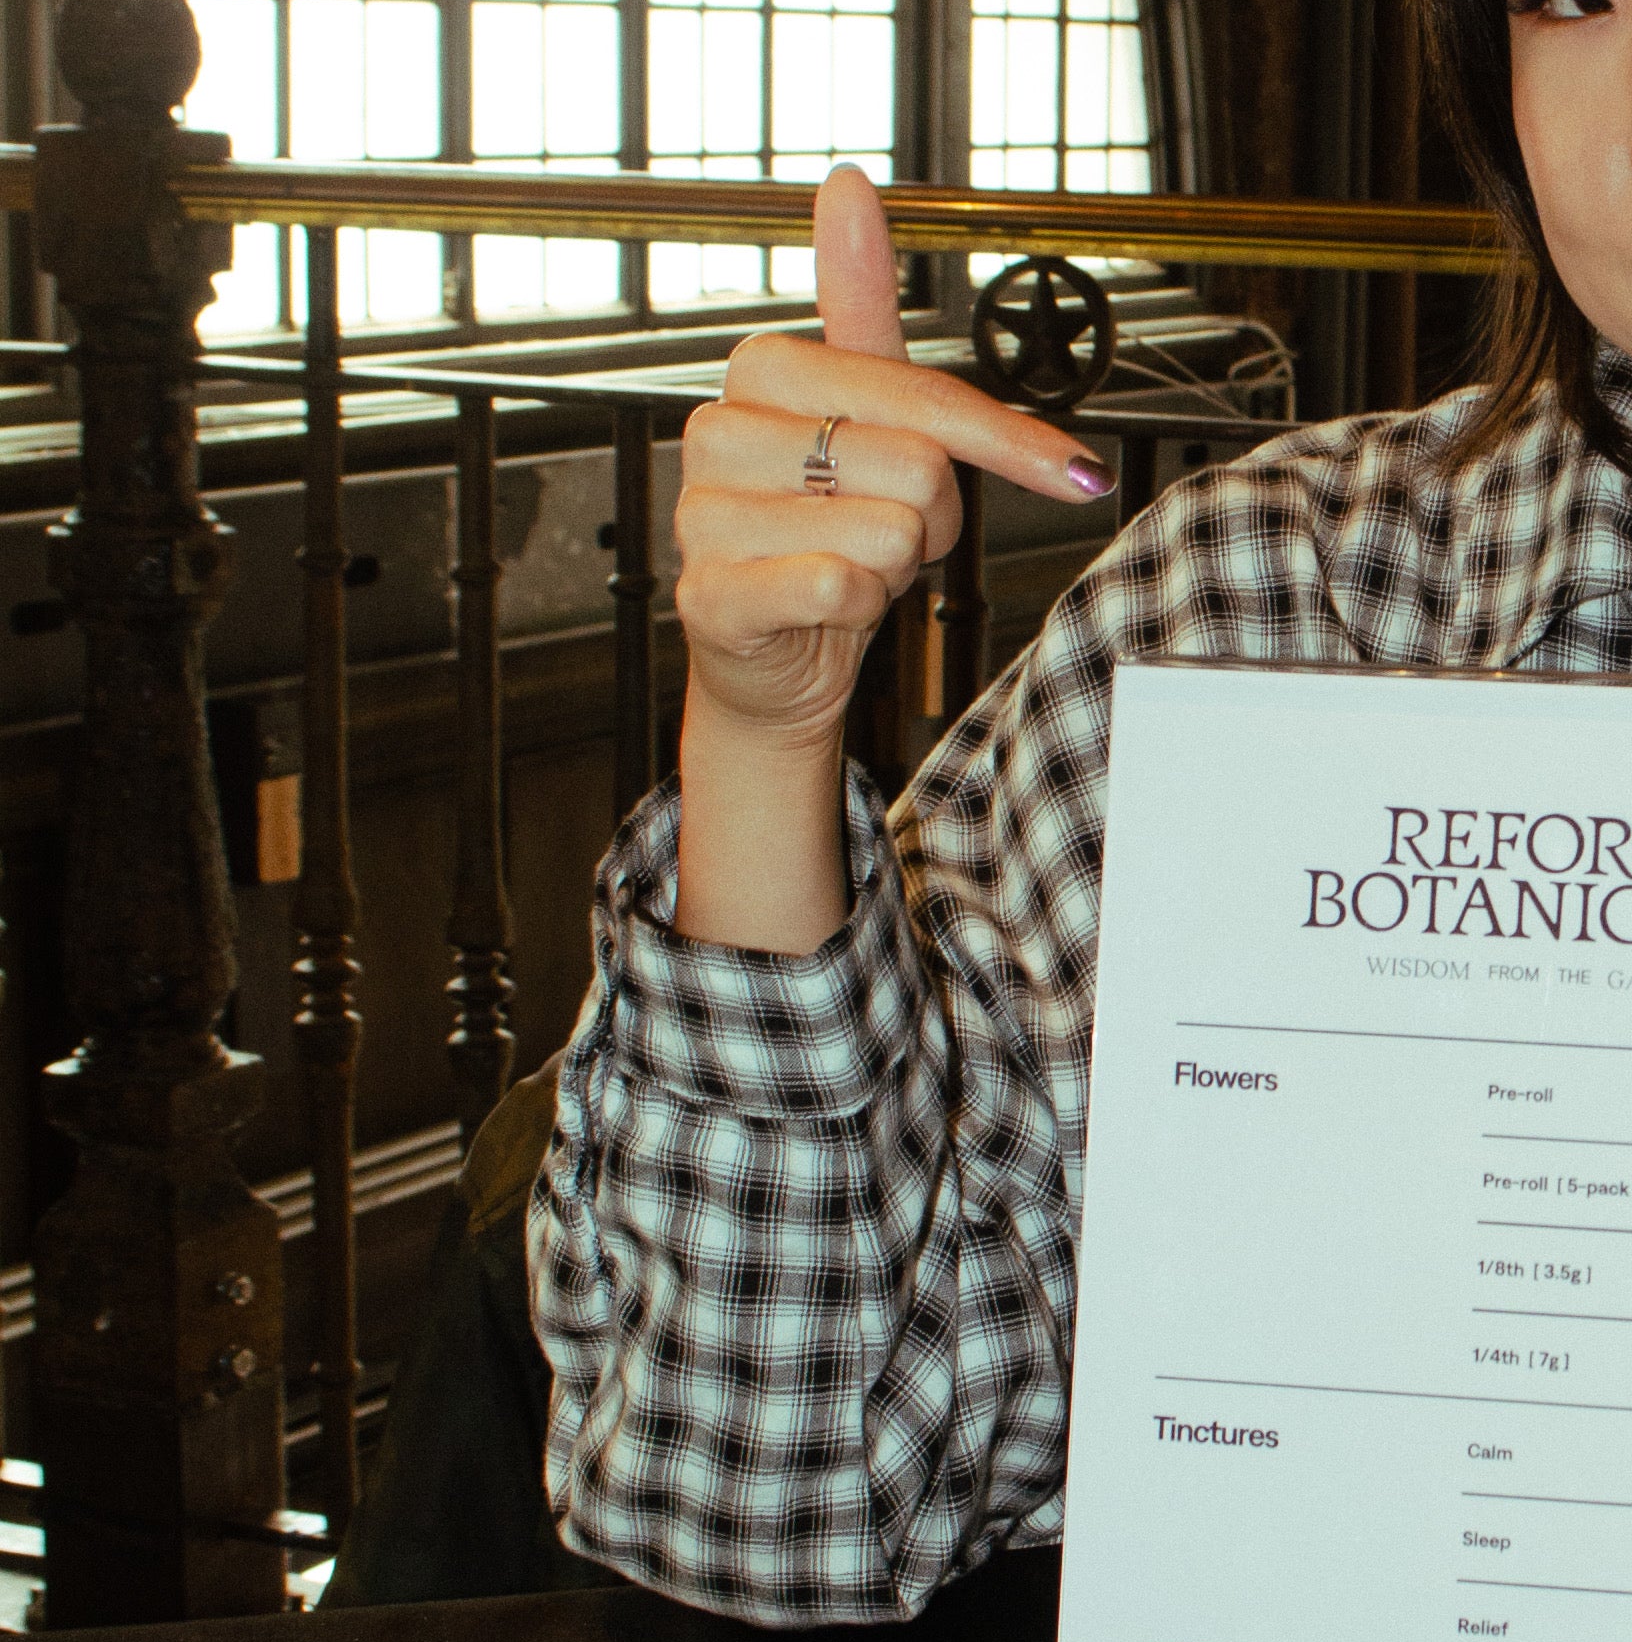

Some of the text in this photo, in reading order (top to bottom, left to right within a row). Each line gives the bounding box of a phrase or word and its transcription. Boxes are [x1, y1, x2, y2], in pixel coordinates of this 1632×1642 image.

[1366, 955, 1471, 981] WISDOM
[1487, 964, 1541, 982] FROM
[1558, 967, 1589, 985] THE
[1174, 1060, 1279, 1092] Flowers
[1487, 1083, 1554, 1103] Pre-roll
[1482, 1171, 1549, 1192] Pre-roll
[1477, 1259, 1525, 1277] 1/8th
[1472, 1347, 1520, 1365] 1/4th
[1153, 1414, 1280, 1449] Tinctures
[1466, 1442, 1514, 1461] Calm
[1462, 1530, 1512, 1553] Sleep
[1456, 1617, 1509, 1637] Relief
